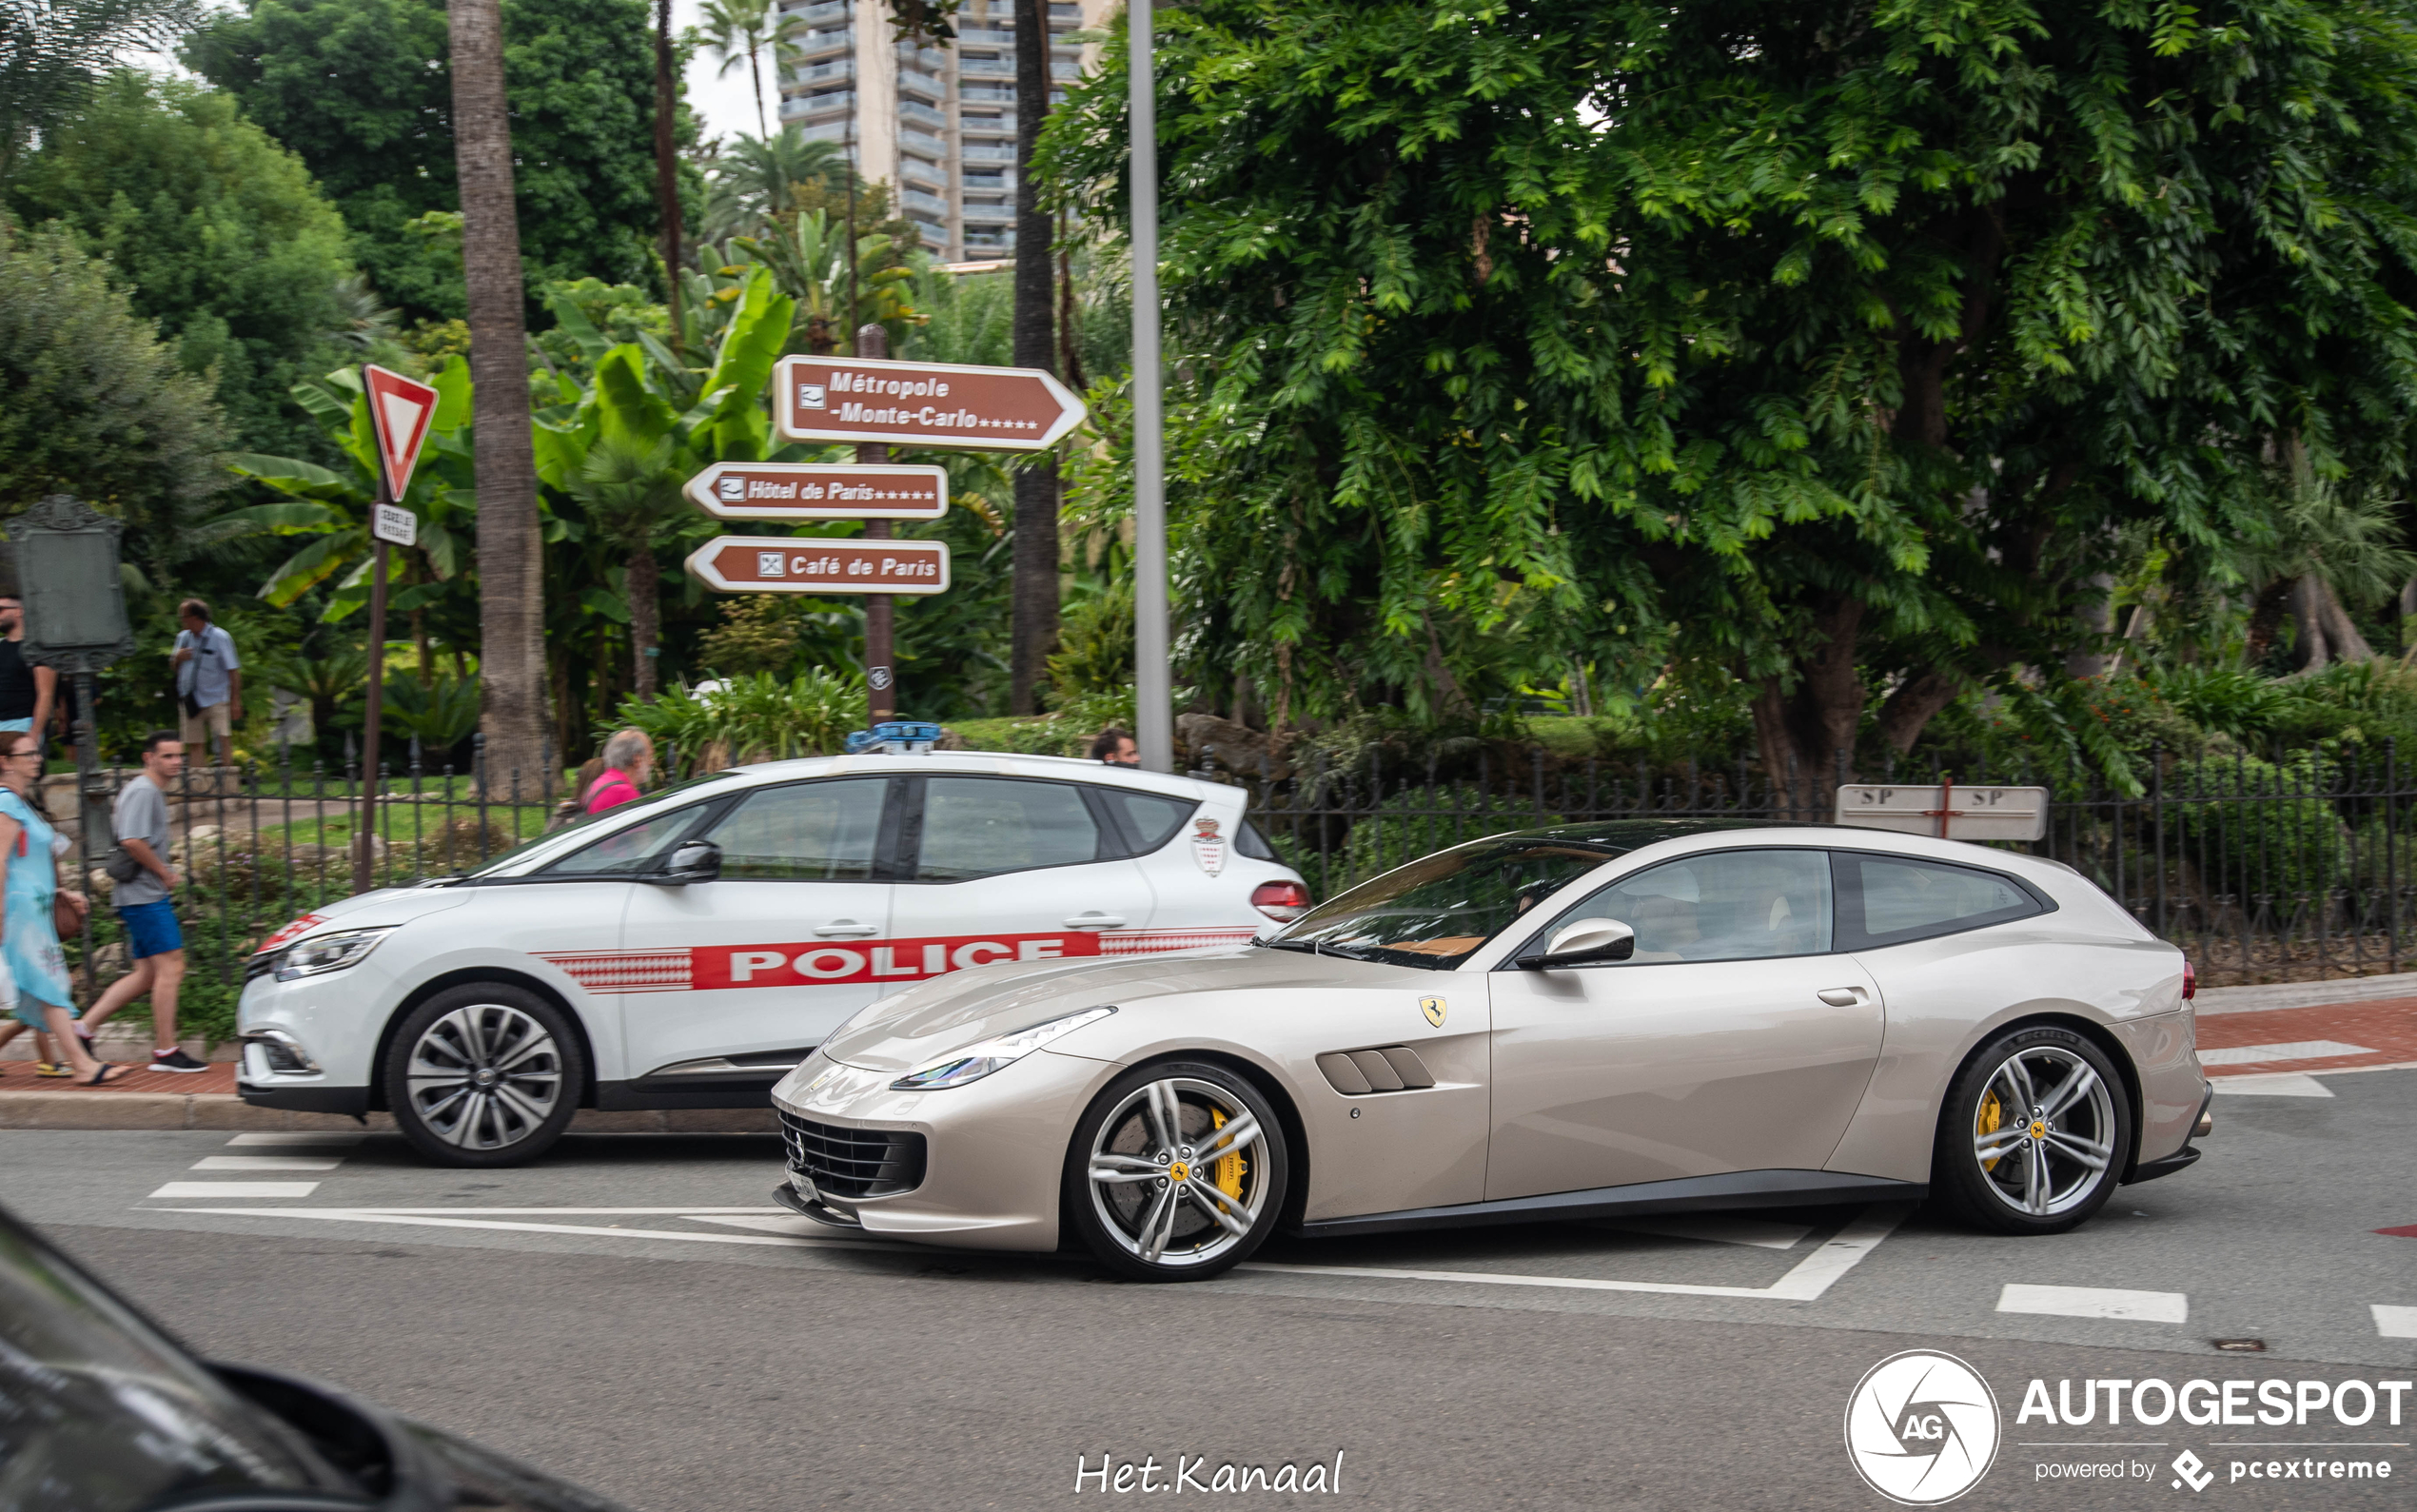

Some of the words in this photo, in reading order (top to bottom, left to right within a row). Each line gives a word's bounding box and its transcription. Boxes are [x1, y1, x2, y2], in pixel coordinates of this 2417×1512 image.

[829, 372, 949, 400] Métropole
[748, 480, 796, 500] Hôtel
[800, 481, 824, 501] de
[827, 481, 874, 501] Paris
[790, 556, 840, 576] Café
[848, 558, 873, 576] de
[880, 559, 936, 578] Paris
[730, 939, 1064, 982] POLICE
